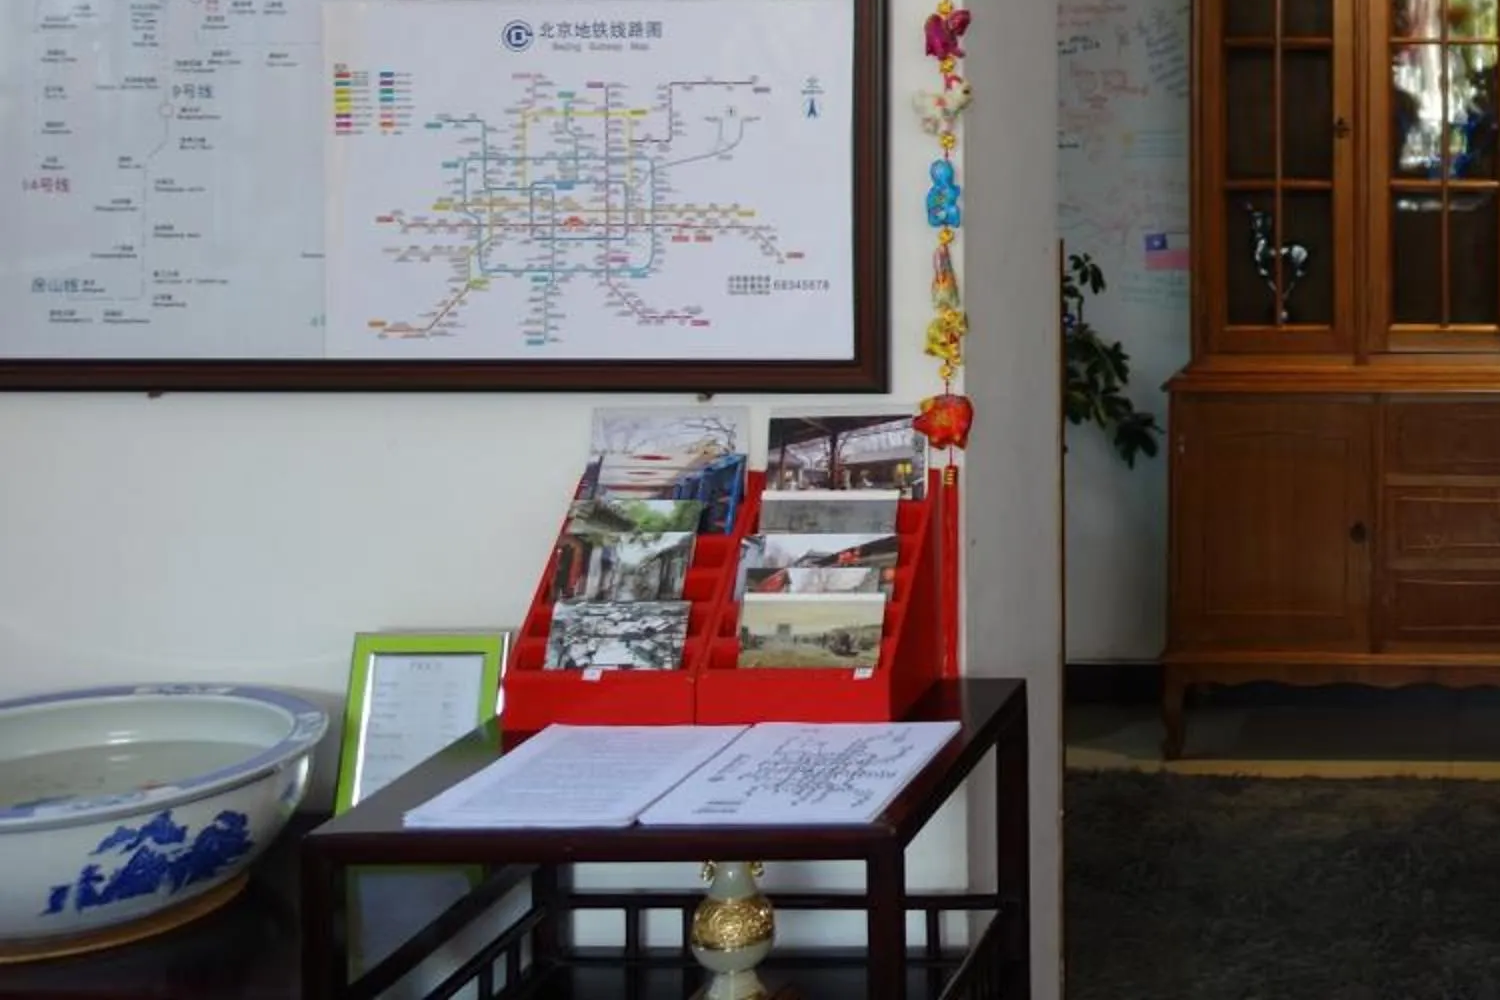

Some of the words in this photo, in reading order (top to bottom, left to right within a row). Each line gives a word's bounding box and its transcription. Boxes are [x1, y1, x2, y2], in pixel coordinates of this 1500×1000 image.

[540, 20, 663, 39] 北京地铁线路图
